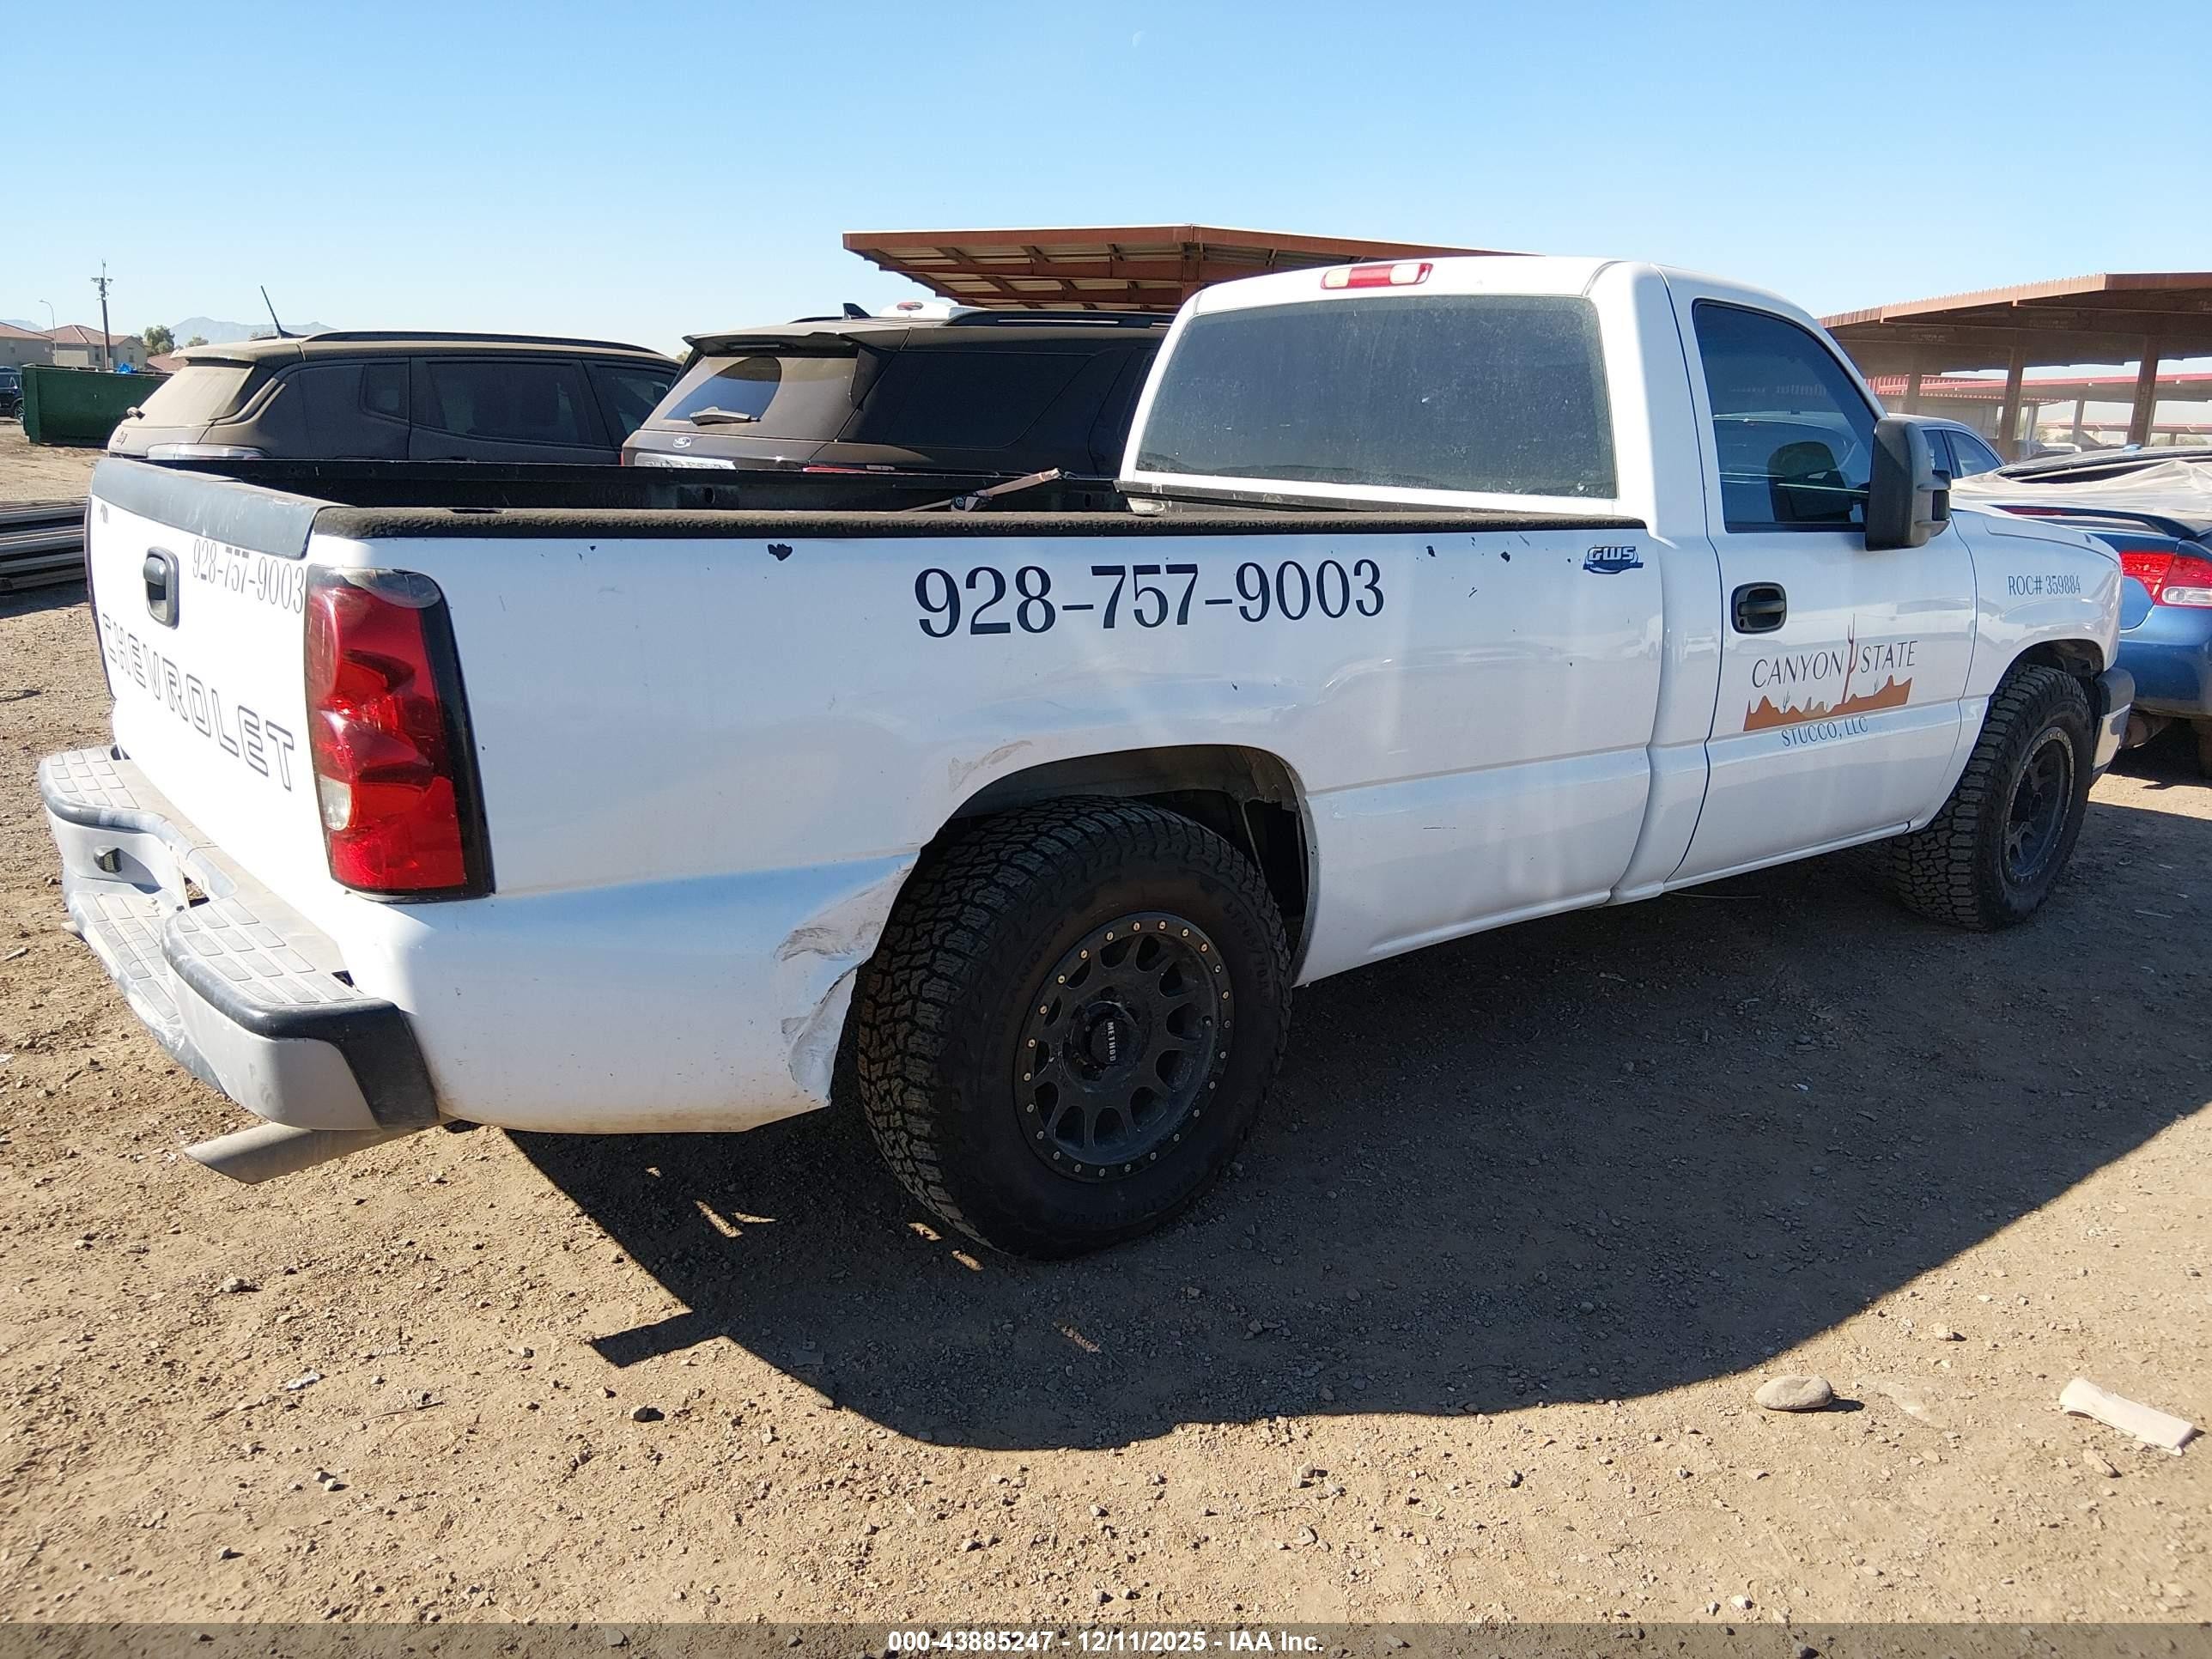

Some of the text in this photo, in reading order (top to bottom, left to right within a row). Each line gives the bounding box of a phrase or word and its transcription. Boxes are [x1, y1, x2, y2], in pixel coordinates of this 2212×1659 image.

[1588, 546, 1636, 561] GWS
[192, 538, 306, 614] 928-757-9003
[2008, 575, 2081, 595] ROC# 359884
[914, 558, 1385, 639] 928-757-9003
[1752, 641, 1918, 689] CANYON STATE
[102, 612, 295, 791] CHEVROLET
[1781, 716, 1869, 747] STUCCO, LLC
[1107, 1022, 1116, 1061] METHOD
